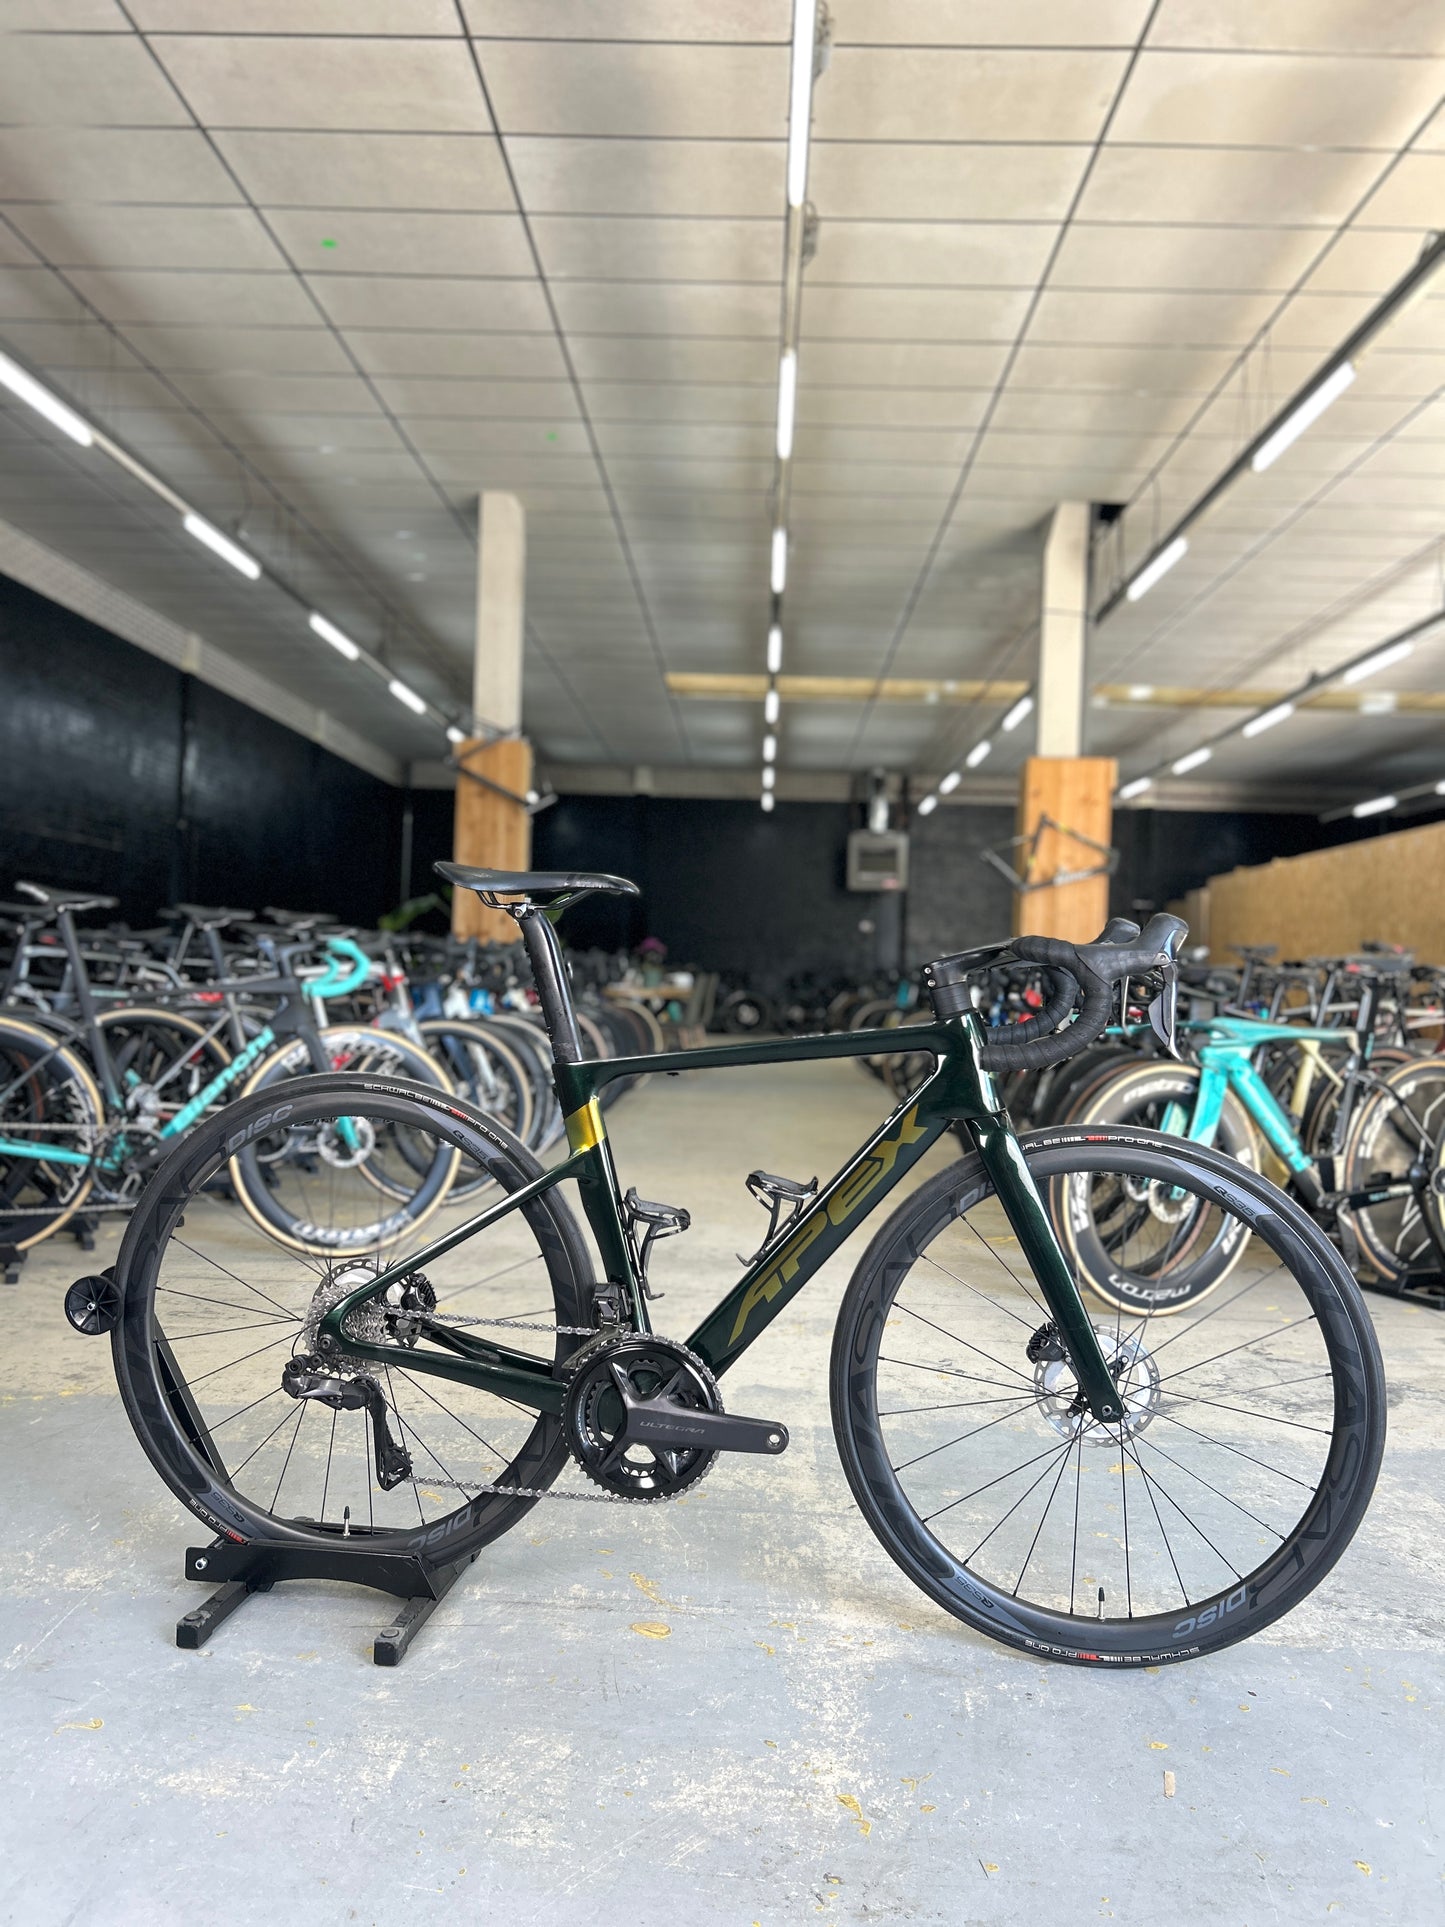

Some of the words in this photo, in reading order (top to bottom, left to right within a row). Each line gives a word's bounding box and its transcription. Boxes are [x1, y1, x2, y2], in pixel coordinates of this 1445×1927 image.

[363, 1083, 431, 1103] SCHWALBE
[226, 1104, 293, 1150] DISC
[452, 1129, 488, 1160] QS35
[1213, 1185, 1257, 1217] QS35
[728, 1102, 928, 1347] APEX
[640, 1420, 706, 1435] ULTEGRA
[210, 1491, 245, 1522] QS35
[406, 1507, 472, 1551] DISC
[954, 1575, 994, 1608] QS35
[1172, 1584, 1247, 1639] DISC
[1124, 1646, 1199, 1663] SCHWALBE
